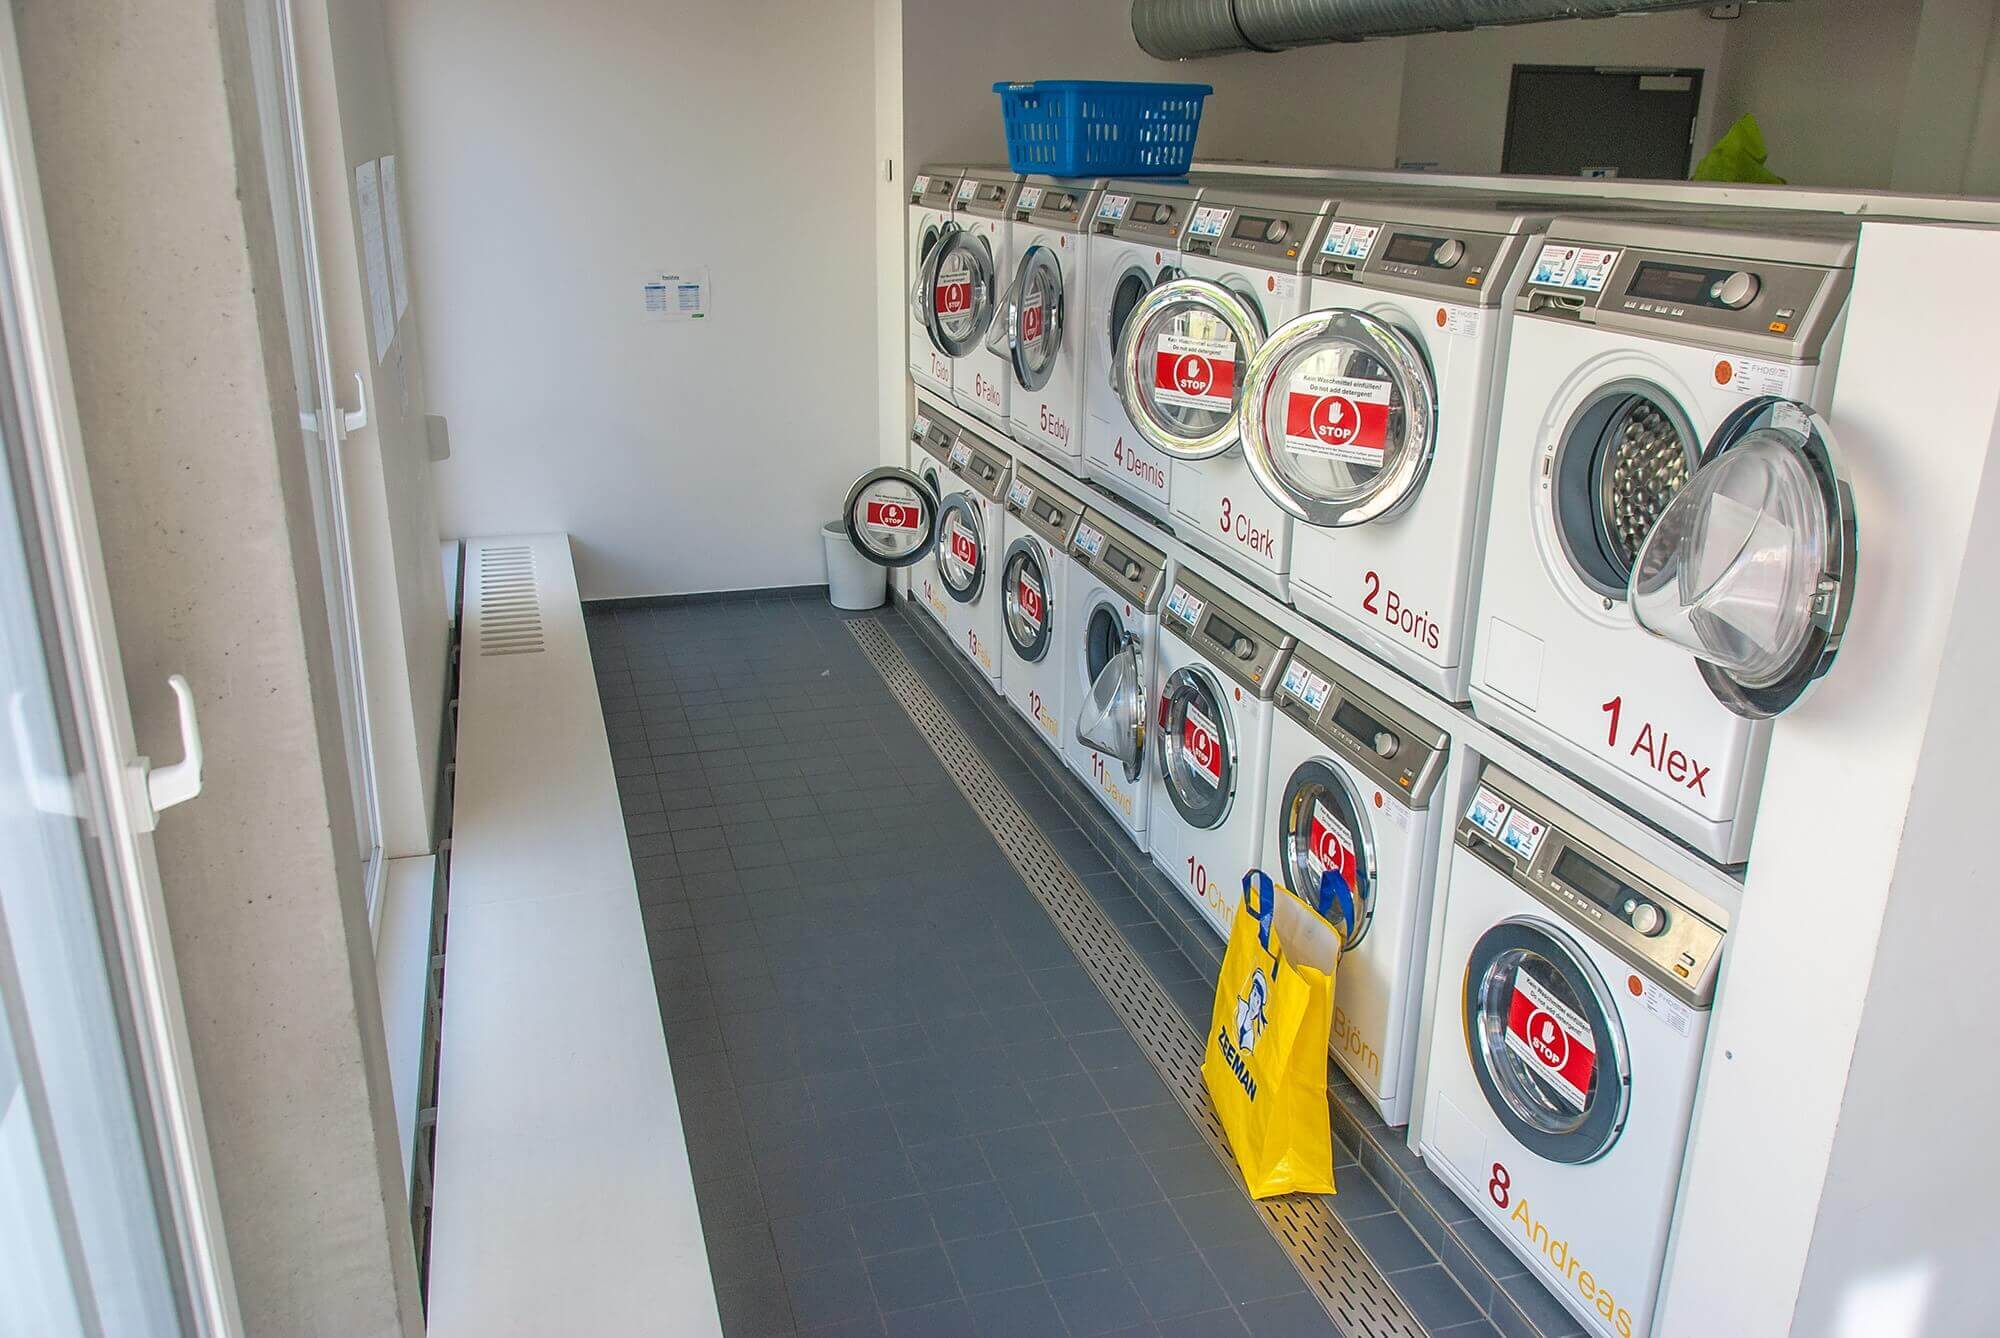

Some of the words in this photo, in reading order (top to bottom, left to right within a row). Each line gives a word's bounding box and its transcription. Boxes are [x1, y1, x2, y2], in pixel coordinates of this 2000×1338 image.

[976, 373, 982, 397] 6
[982, 381, 1001, 407] Falko
[1180, 378, 1206, 390] STOP
[1329, 386, 1341, 394] add
[1040, 404, 1047, 431] 5
[1049, 413, 1070, 447] Eddy
[1318, 425, 1352, 439] STOP
[1114, 436, 1123, 466] 4
[1127, 448, 1165, 489] Dennis
[1220, 497, 1232, 533] 3
[1236, 514, 1274, 559] Clark
[1362, 571, 1380, 615] 2
[1386, 590, 1440, 649] Boris
[968, 629, 978, 656] 13
[1029, 690, 1041, 721] 12
[1602, 695, 1622, 747] 1
[1630, 722, 1711, 797] Alex
[1092, 752, 1104, 785] 11
[1187, 856, 1206, 896] 10
[1334, 1006, 1379, 1077] Björn
[1532, 1037, 1560, 1064] STOP
[1489, 1162, 1511, 1209] 8
[1511, 1198, 1632, 1338] Andreas
